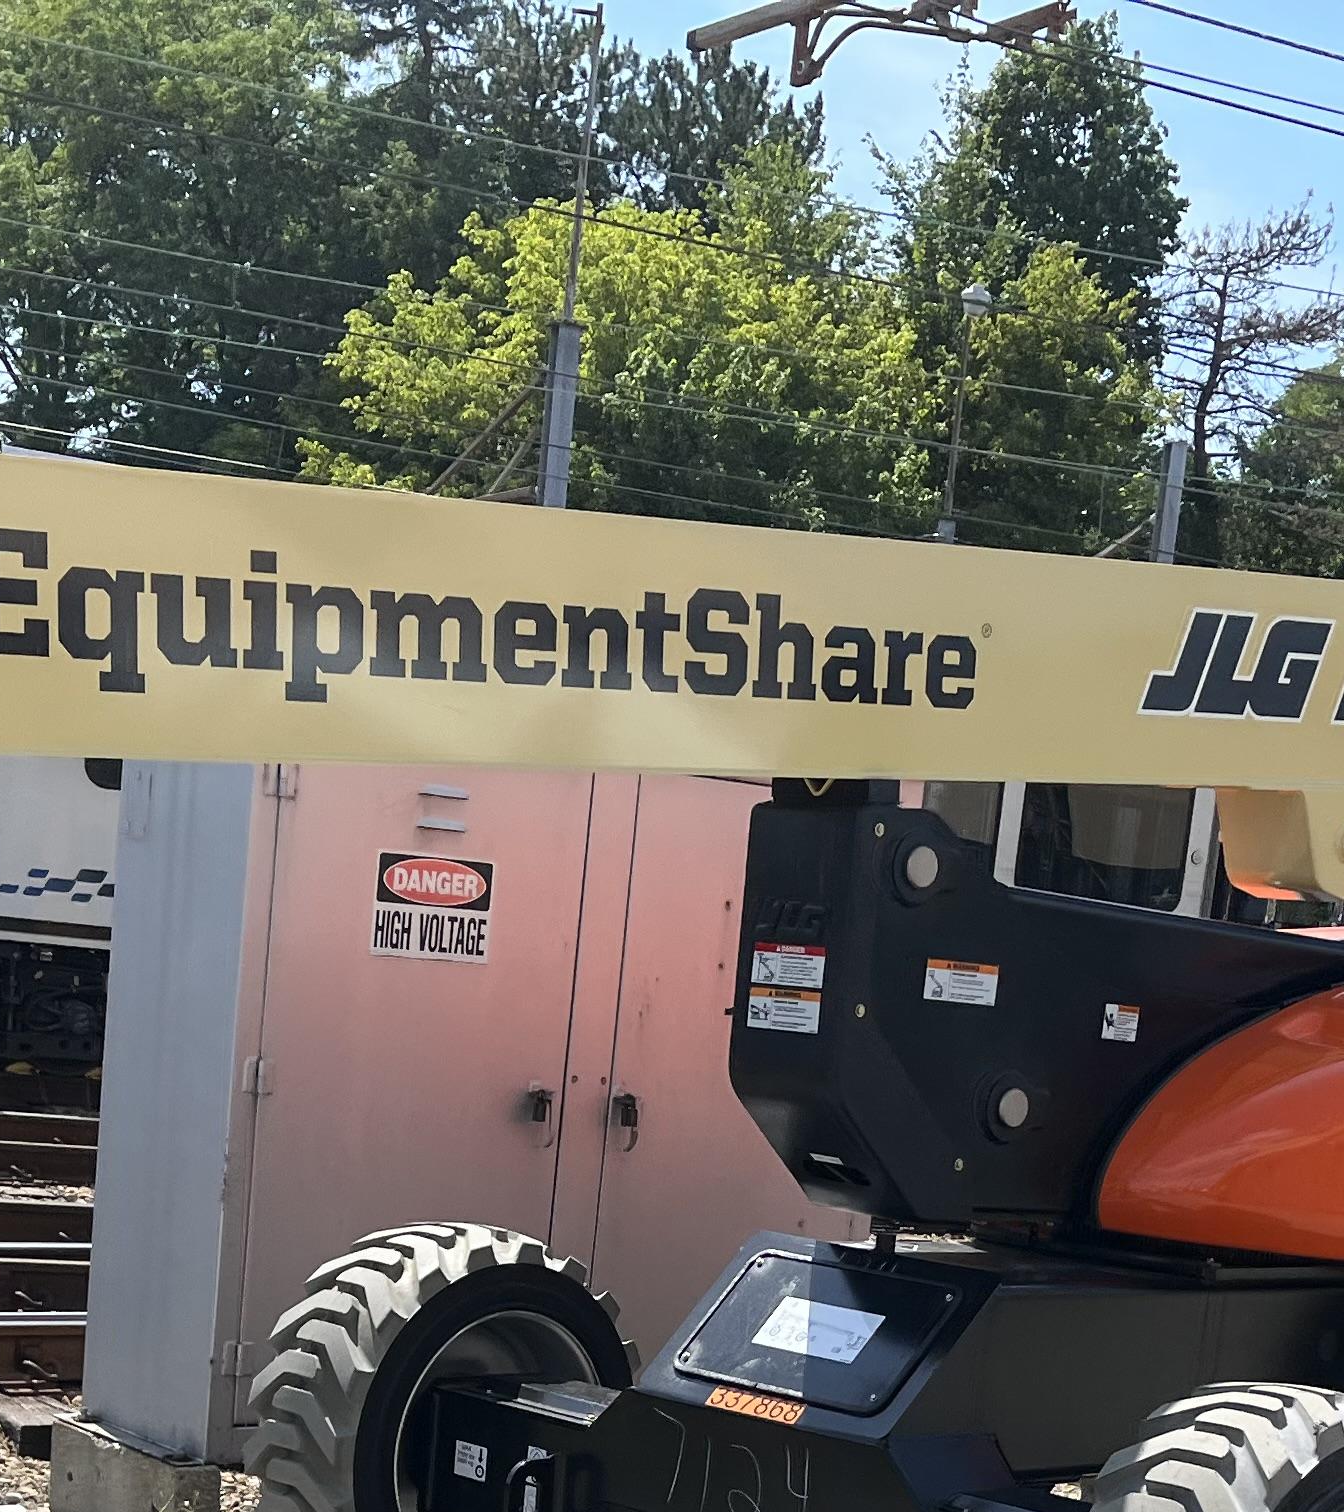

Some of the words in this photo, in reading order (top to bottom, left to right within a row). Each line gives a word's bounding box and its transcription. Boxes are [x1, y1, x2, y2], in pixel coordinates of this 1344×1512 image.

[1137, 607, 1336, 724] JLG
[393, 867, 478, 898] DANGER
[374, 909, 412, 950] HIGH
[419, 913, 487, 956] VOLTAGE
[711, 1388, 801, 1423] 337868
